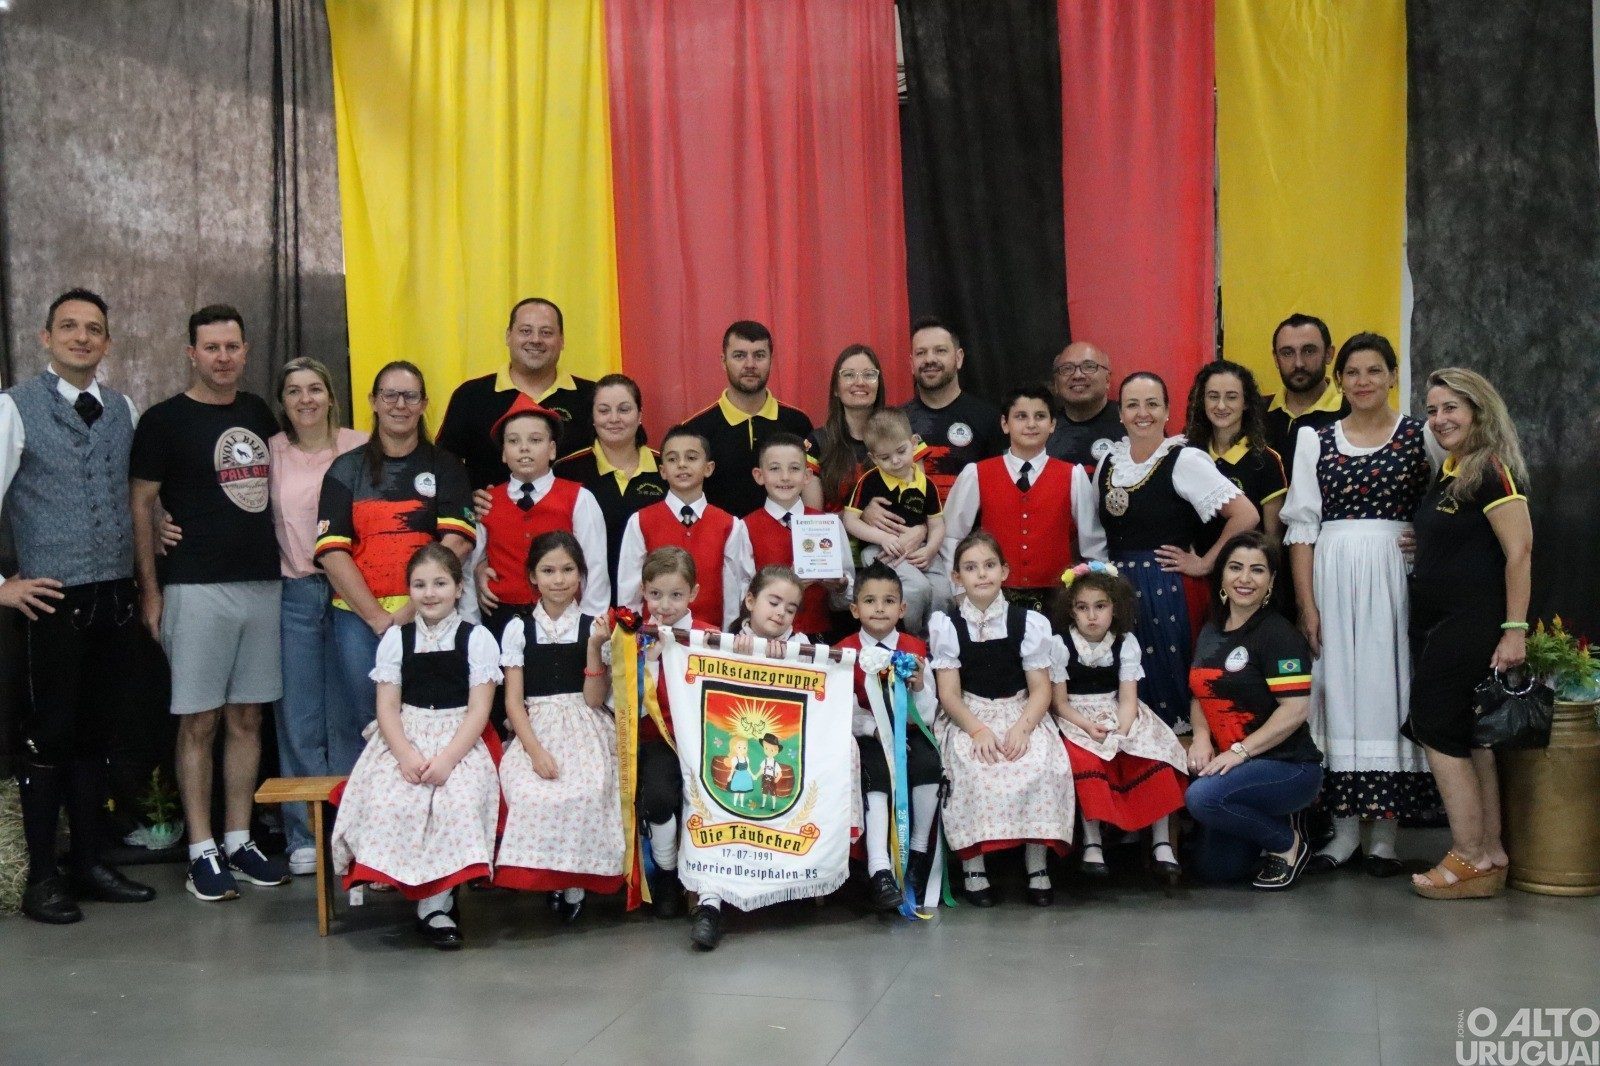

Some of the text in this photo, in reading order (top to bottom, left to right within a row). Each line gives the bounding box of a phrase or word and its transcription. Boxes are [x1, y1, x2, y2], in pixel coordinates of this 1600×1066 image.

[222, 435, 265, 464] WOLF BEER
[220, 467, 249, 481] PALE
[699, 658, 819, 688] Volkstanzgruppe
[700, 825, 801, 852] Die Täubchen
[722, 848, 773, 861] 17-07-1991
